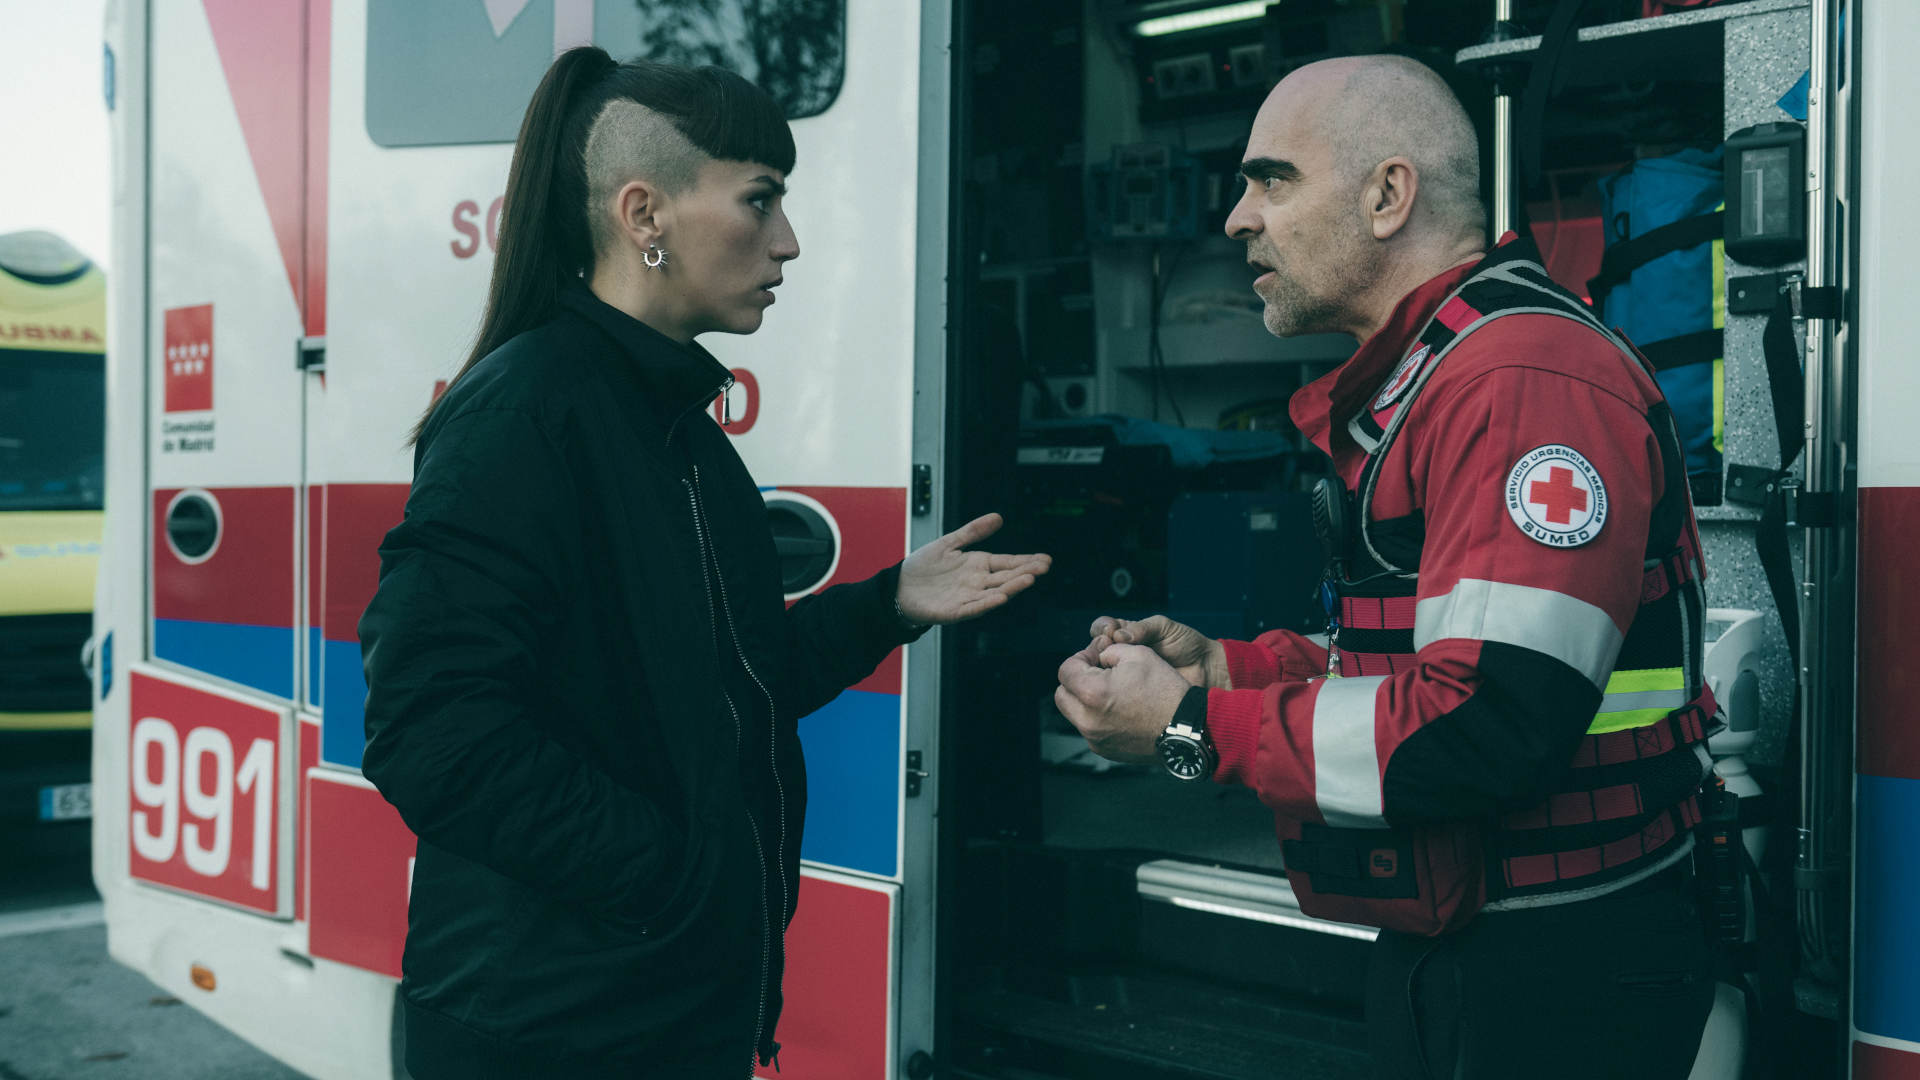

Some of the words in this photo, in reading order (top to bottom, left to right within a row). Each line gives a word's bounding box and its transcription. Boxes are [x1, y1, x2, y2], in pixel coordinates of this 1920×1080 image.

[162, 421, 215, 433] Comunidad
[163, 439, 175, 452] de
[179, 438, 215, 452] Madrid
[1509, 460, 1530, 509] SERVICIO
[1529, 448, 1592, 473] URGENCIAS
[1522, 521, 1590, 545] SUMED
[132, 716, 275, 890] 991
